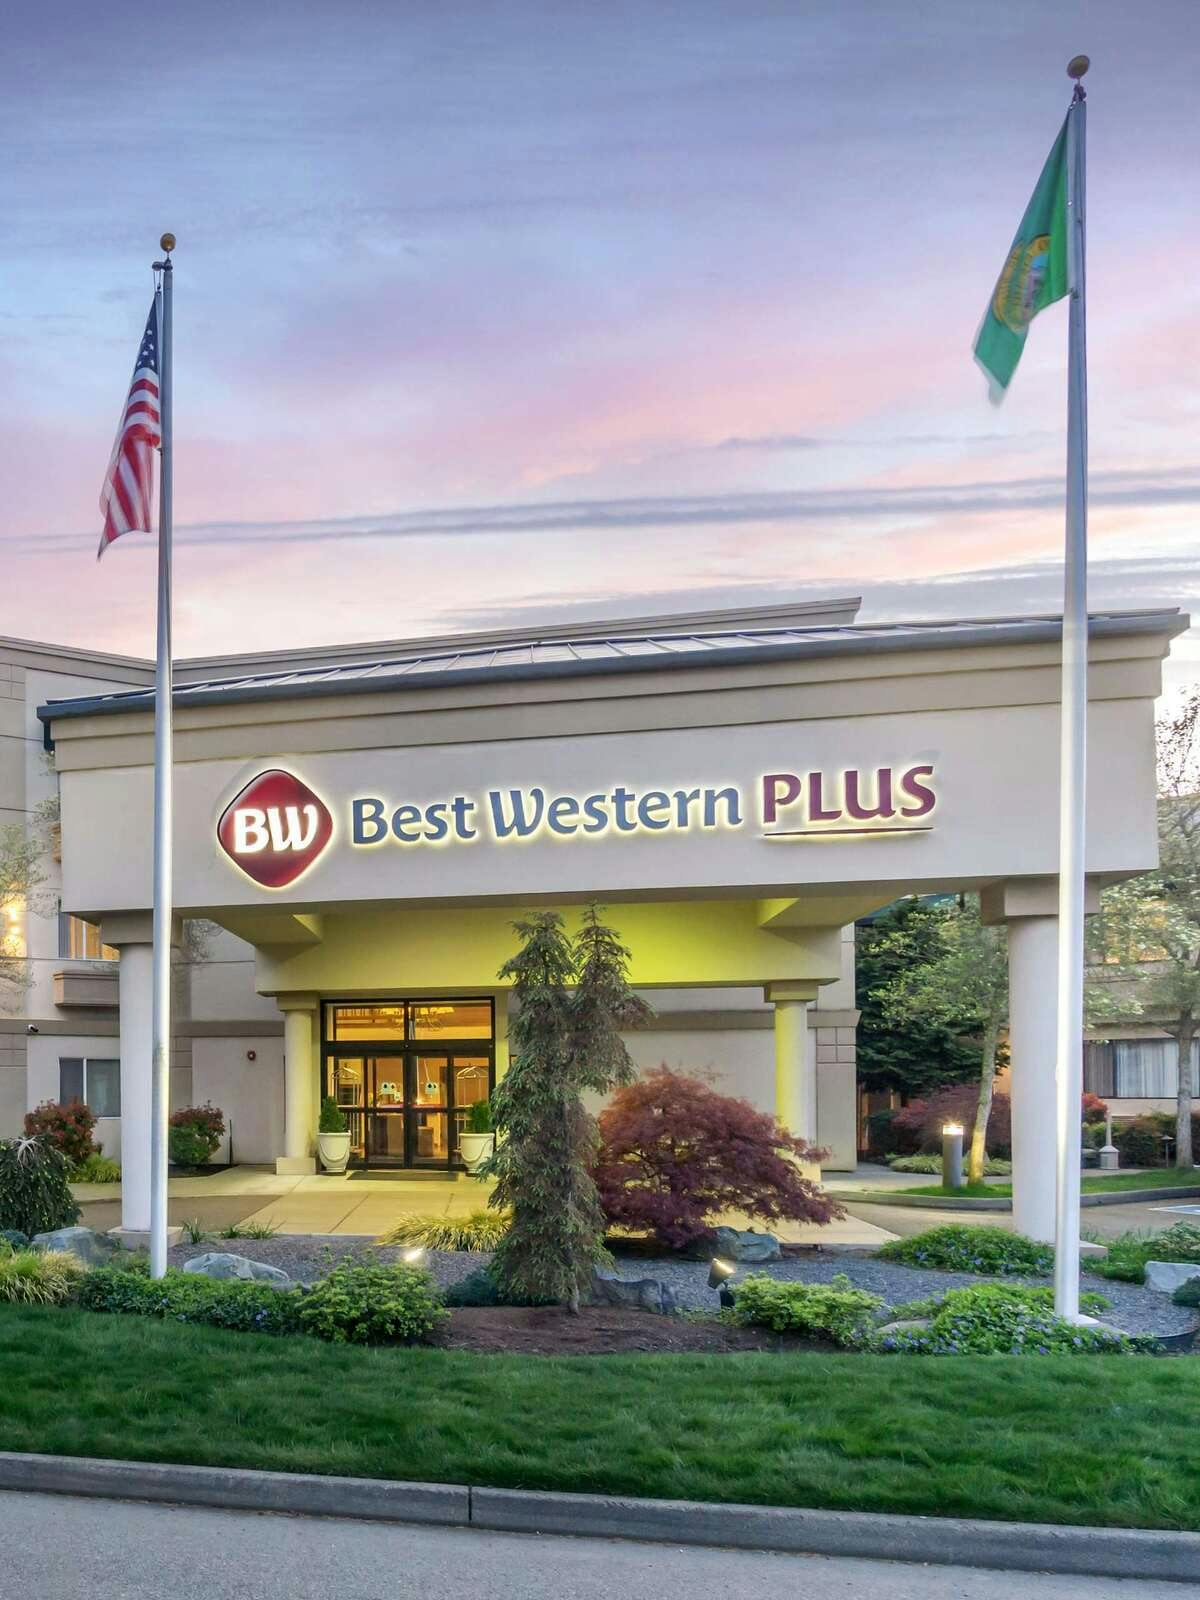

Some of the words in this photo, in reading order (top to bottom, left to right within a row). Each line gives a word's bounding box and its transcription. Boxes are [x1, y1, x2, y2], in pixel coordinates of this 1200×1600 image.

[233, 804, 317, 854] BW
[352, 797, 476, 846] Best
[489, 786, 743, 840] Western
[762, 764, 937, 823] PLUS
